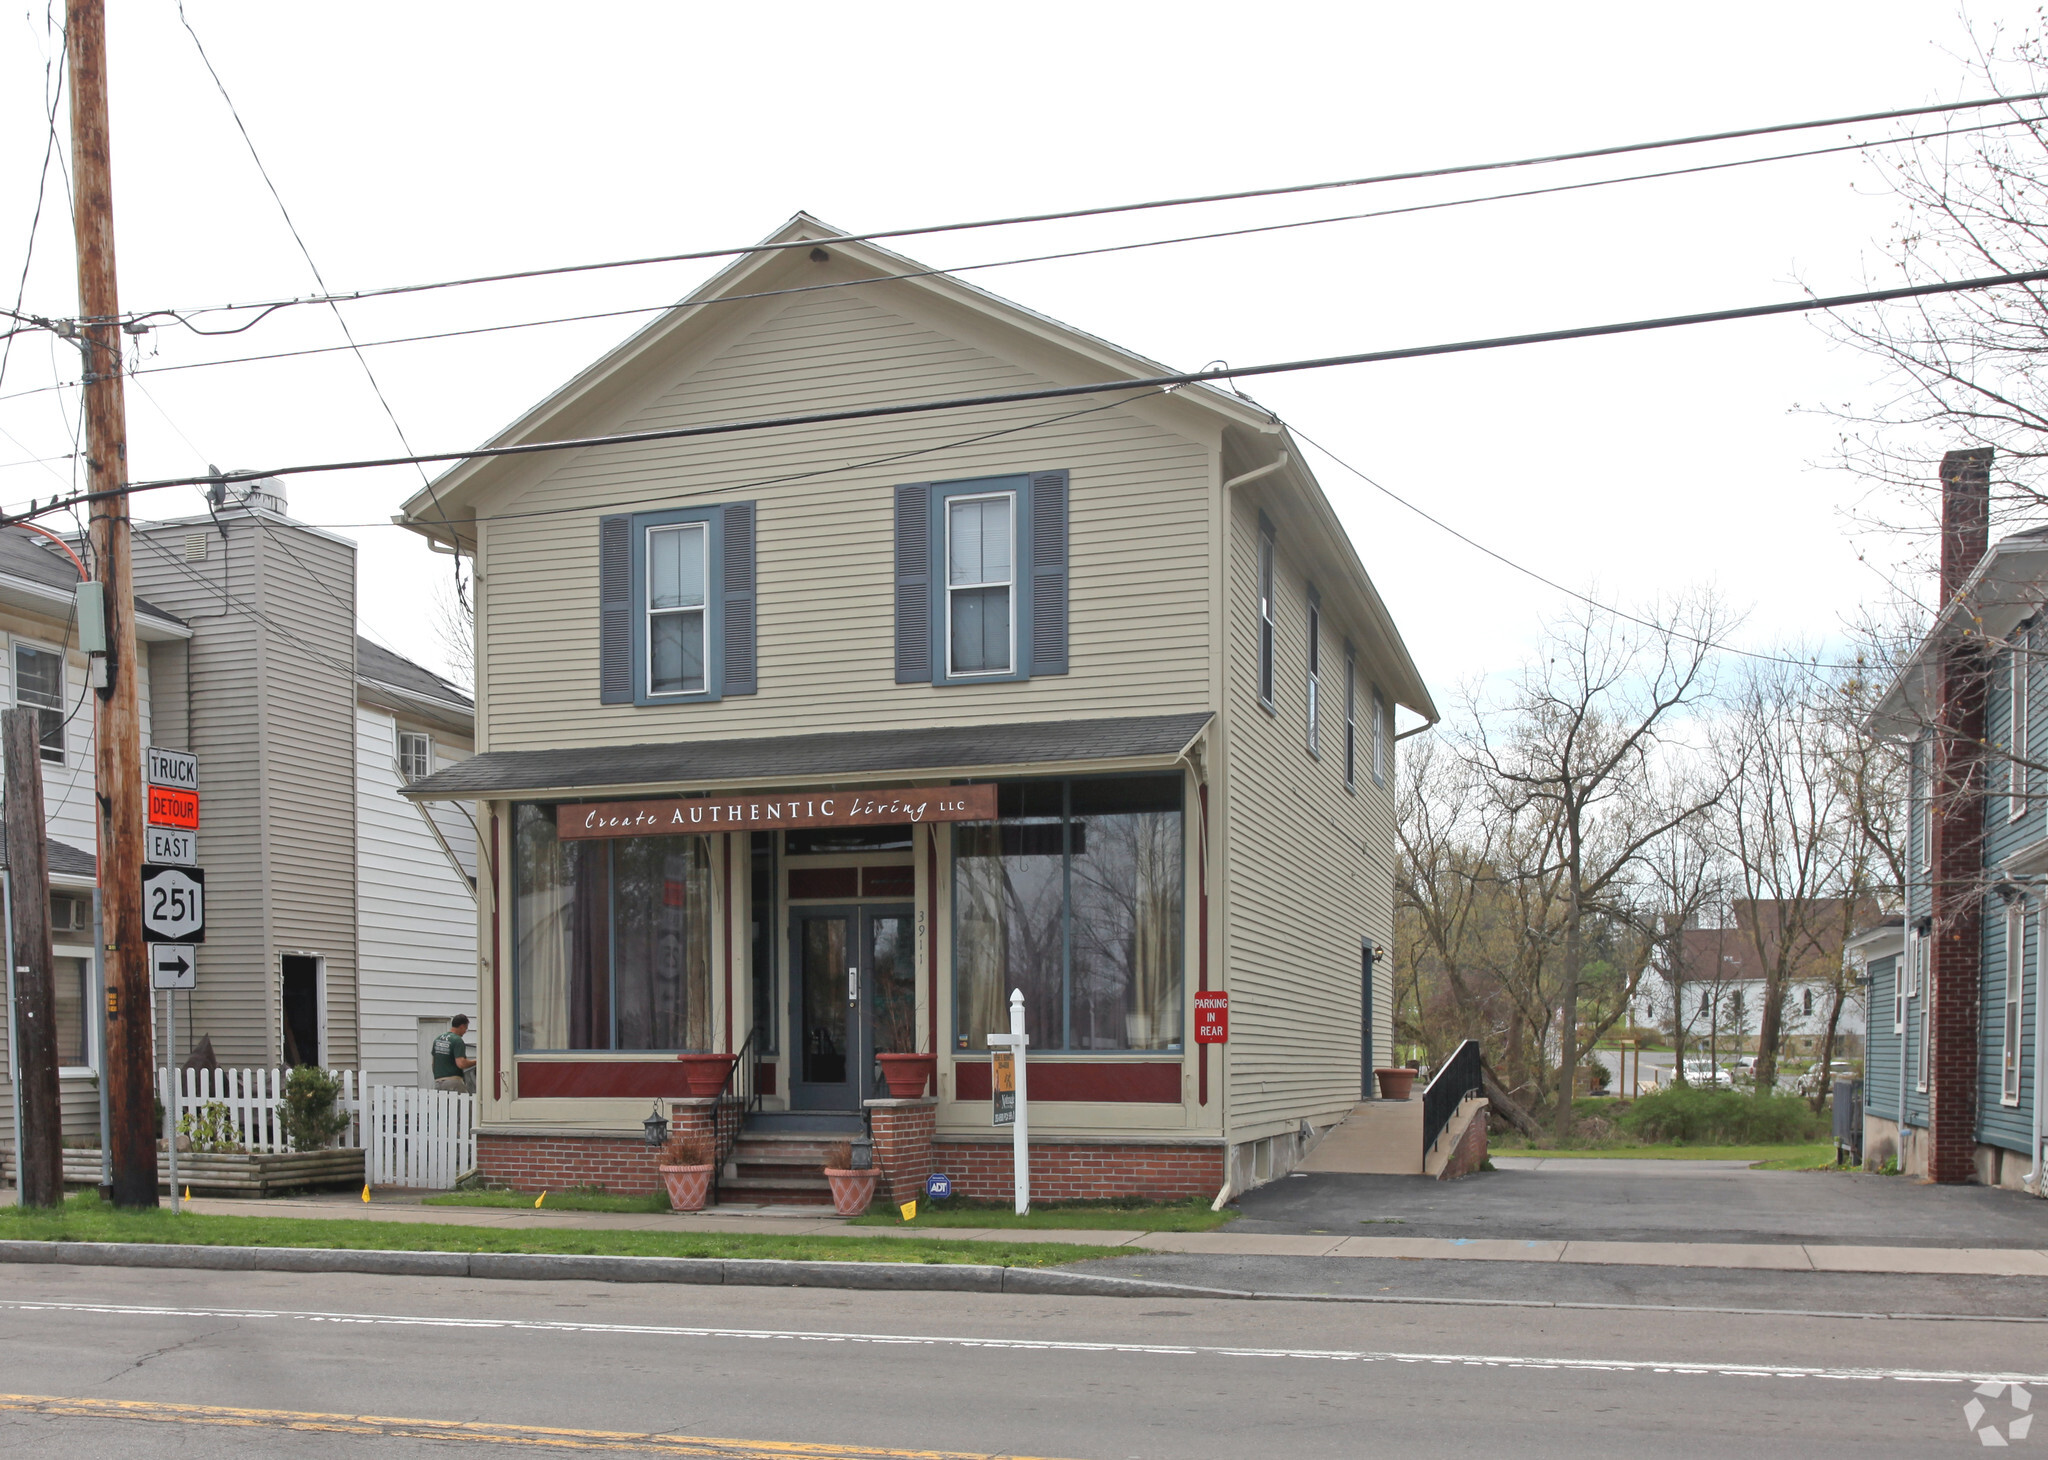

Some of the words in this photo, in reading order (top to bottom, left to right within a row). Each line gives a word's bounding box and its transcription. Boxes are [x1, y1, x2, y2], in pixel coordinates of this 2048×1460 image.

[151, 756, 194, 783] TRUCK
[153, 797, 194, 819] DETOUR
[585, 809, 657, 829] Create
[671, 800, 834, 824] AUTHENTIC
[850, 798, 927, 822] Living
[940, 801, 965, 811] LLC
[155, 837, 189, 858] EAST
[152, 887, 195, 922] 251
[917, 910, 926, 965] 3911
[1194, 998, 1228, 1009] PARKING
[1207, 1012, 1216, 1022] IN
[1200, 1026, 1223, 1036] REAR
[930, 1182, 947, 1193] ADT
